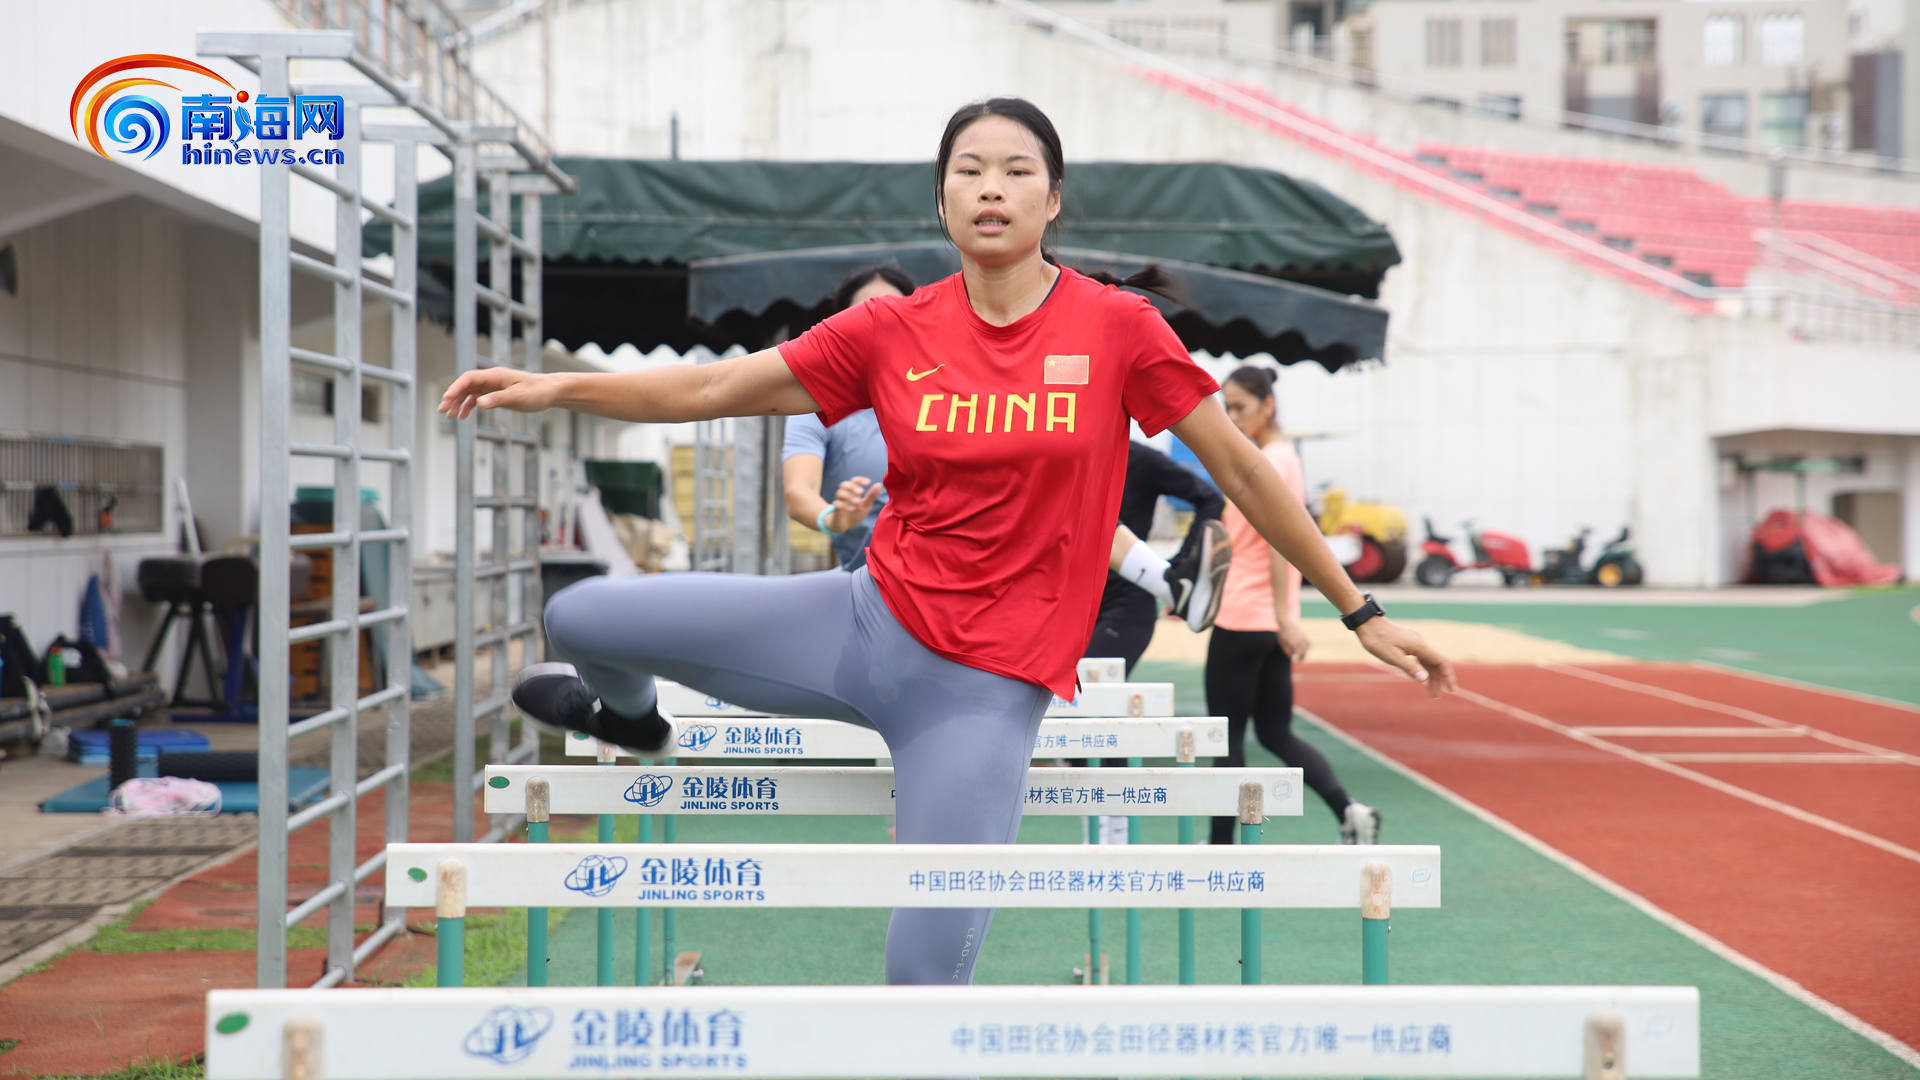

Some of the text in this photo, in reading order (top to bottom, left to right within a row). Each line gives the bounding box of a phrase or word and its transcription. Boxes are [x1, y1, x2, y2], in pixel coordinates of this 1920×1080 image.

[915, 391, 1077, 434] CHINA
[723, 726, 803, 746] 金陵体育
[723, 746, 804, 755] JINLING SPORTS
[681, 776, 778, 800] 金陵体育
[680, 801, 780, 811] JINLING SPORTS
[639, 857, 764, 888] 金陵体育
[909, 869, 1266, 893] 中国田径协会田径器材类官方唯一供应商
[637, 889, 766, 902] JINLING SPORTS
[572, 1008, 744, 1048] 金陵体育
[952, 1023, 1452, 1055] 中国田径协会田径器材类官方唯一供应商
[569, 1053, 748, 1070] JINLING SPORTS
